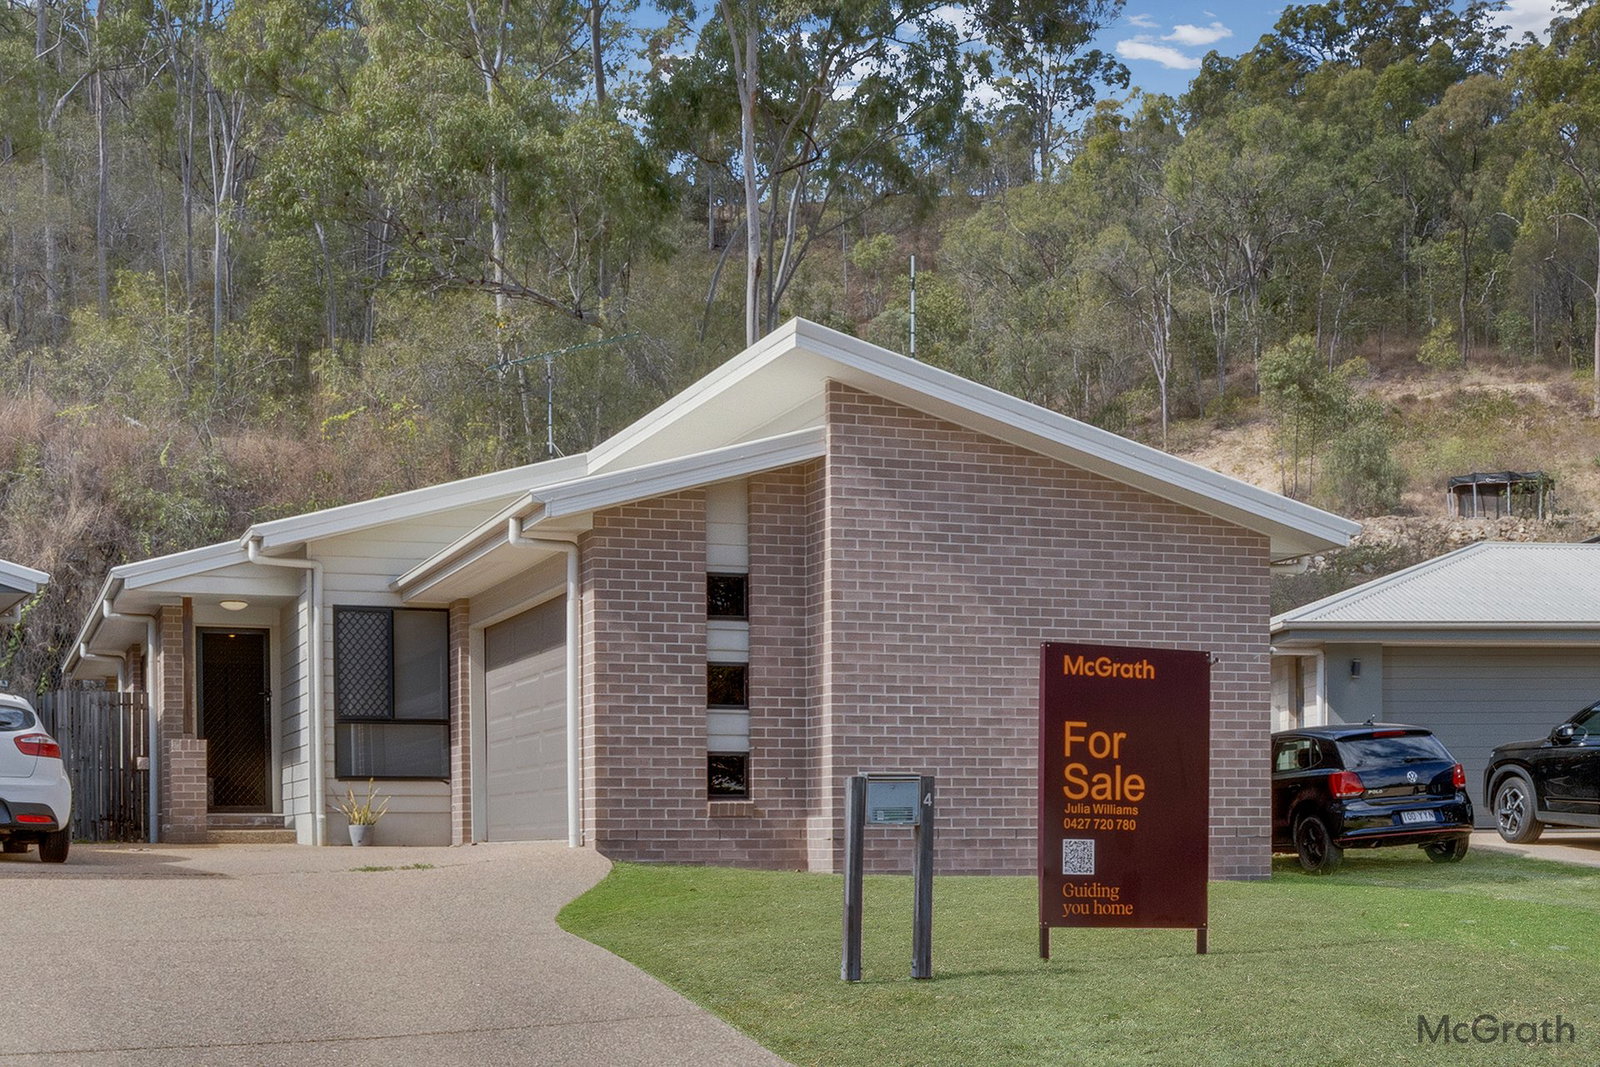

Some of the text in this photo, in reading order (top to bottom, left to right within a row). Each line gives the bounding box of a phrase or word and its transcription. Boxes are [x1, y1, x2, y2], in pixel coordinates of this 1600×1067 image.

[1063, 654, 1156, 680] McGrath
[1064, 720, 1128, 759] For
[1063, 762, 1146, 802] Sale
[923, 792, 933, 807] 4
[1064, 803, 1139, 816] Julia Williams
[1063, 818, 1137, 831] 0427 720 780
[1062, 882, 1120, 901] Guiding
[1062, 900, 1134, 918] you home
